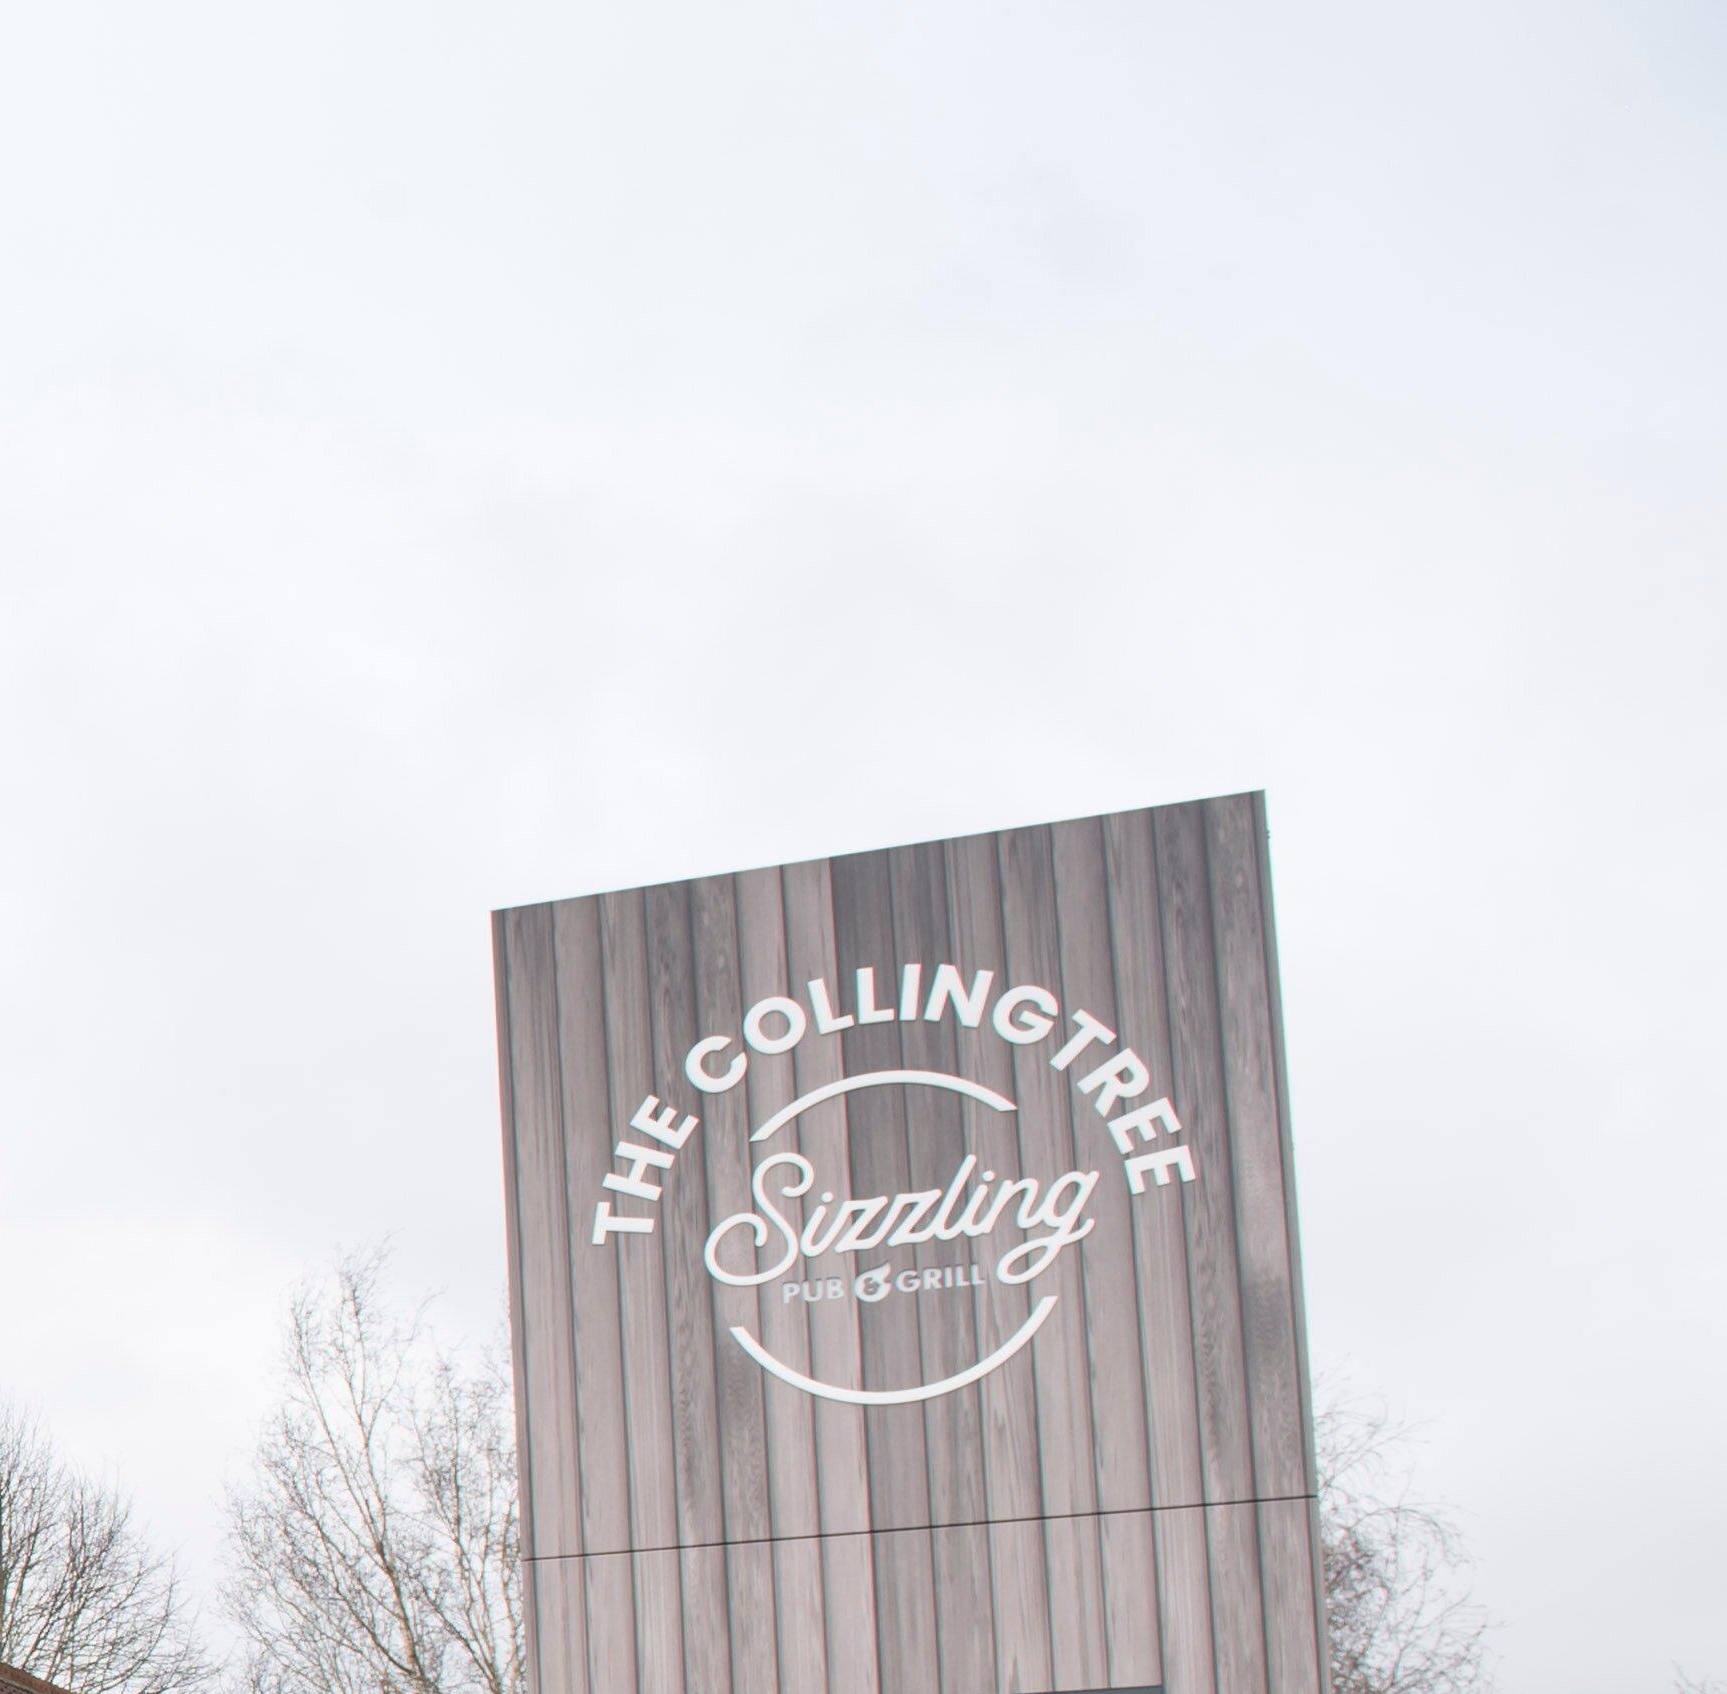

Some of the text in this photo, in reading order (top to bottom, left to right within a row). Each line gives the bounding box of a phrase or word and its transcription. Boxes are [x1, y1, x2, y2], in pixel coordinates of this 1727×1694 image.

[592, 963, 1197, 1246] THE COLLINGTREE
[704, 1152, 1100, 1287] Sizzling
[782, 1277, 844, 1304] PUB
[896, 1264, 985, 1293] GRILL
